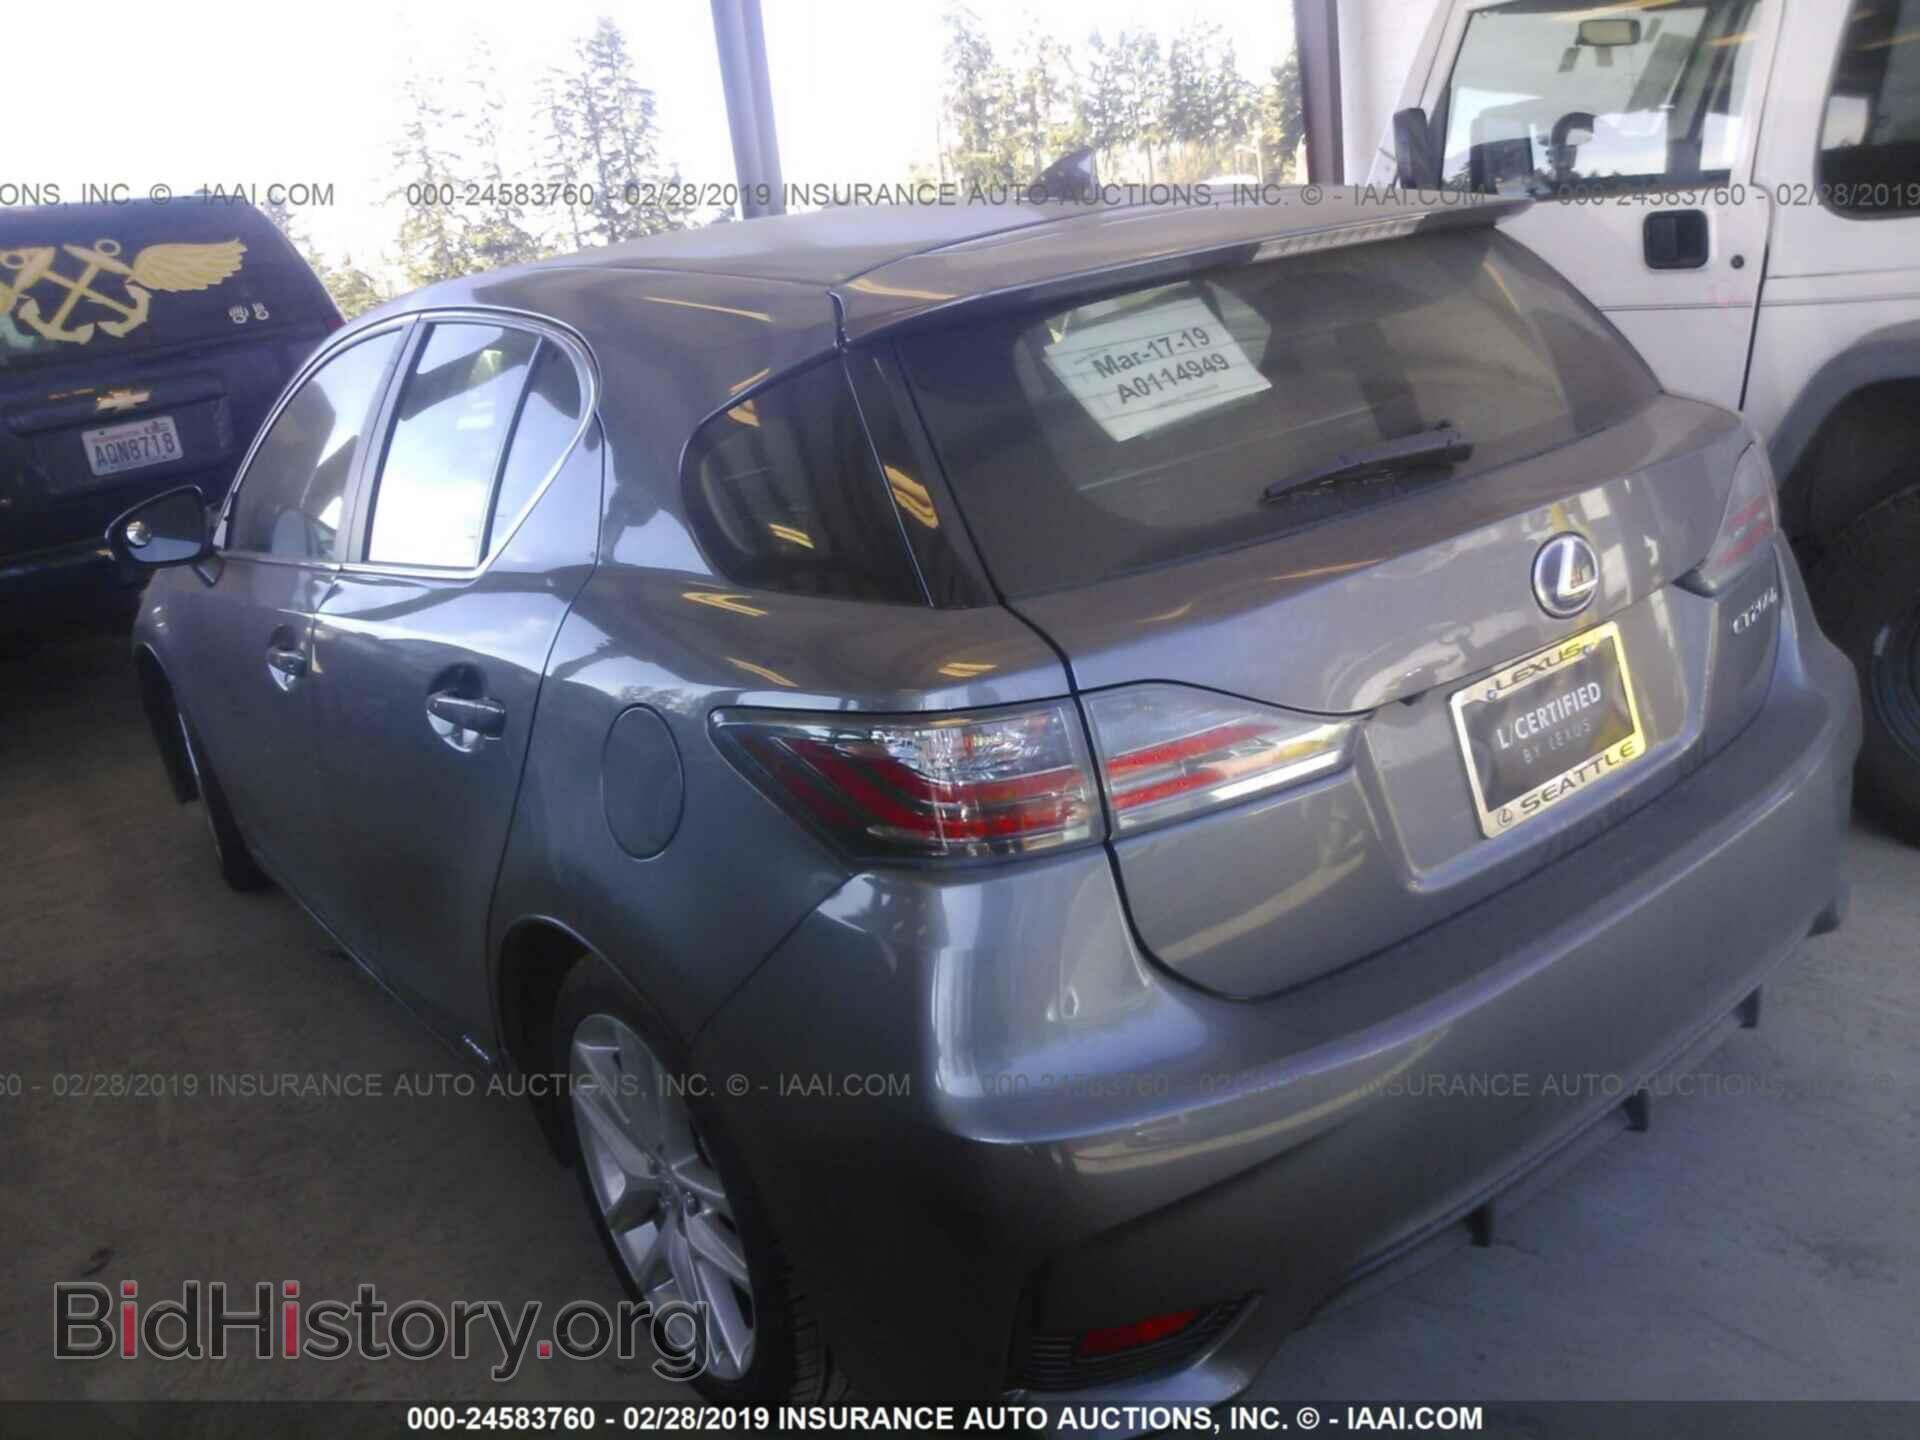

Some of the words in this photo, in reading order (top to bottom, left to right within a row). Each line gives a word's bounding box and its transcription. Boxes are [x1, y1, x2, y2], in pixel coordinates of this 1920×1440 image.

[1092, 327, 1210, 378] Mar-17-19
[1117, 353, 1229, 404] A0114949
[1496, 643, 1582, 690] LEXUS
[1520, 741, 1634, 815] SEATTLE
